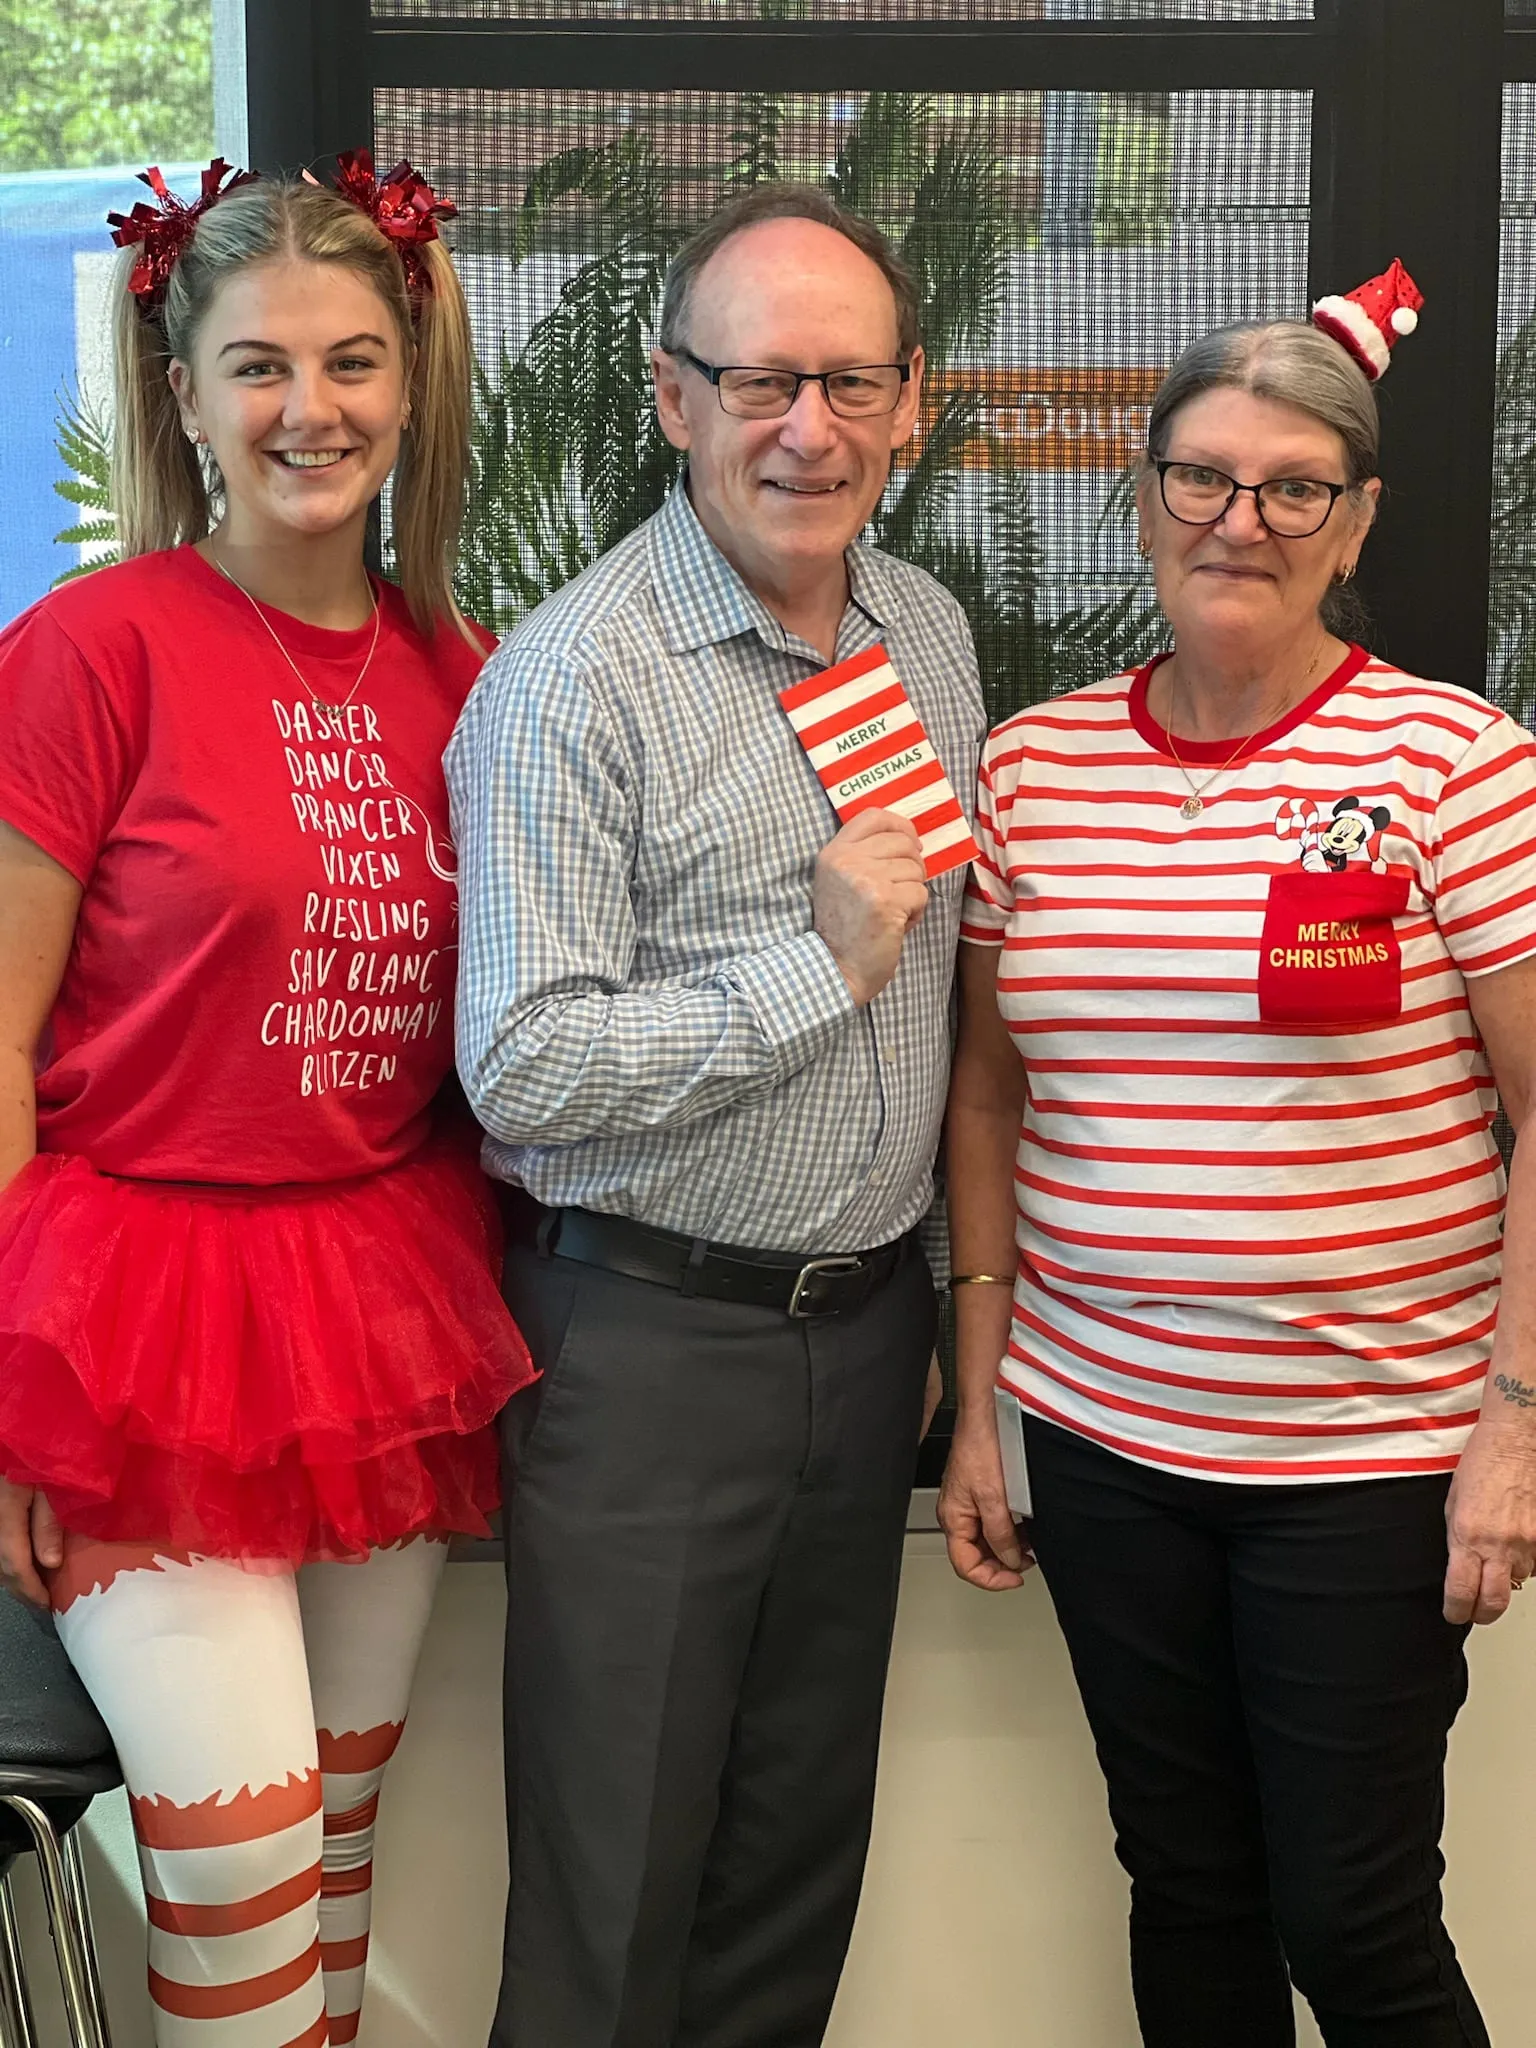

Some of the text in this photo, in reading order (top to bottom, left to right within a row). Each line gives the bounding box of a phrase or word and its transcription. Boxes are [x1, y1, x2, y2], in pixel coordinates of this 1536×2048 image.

[271, 699, 383, 744] DASHER
[835, 717, 887, 754] MERRY
[284, 746, 395, 793] DANCER
[838, 747, 923, 798] CHRISTMAS
[290, 792, 417, 843] PRANCER
[319, 844, 401, 890] VIXEN
[303, 891, 430, 942] RIESLING
[1297, 921, 1360, 943] MERRY
[287, 947, 439, 995] SAV BLANC
[1269, 943, 1389, 969] CHRISTMAS
[260, 997, 443, 1049] CHARDONNAY
[300, 1049, 397, 1097] BLITZEN
